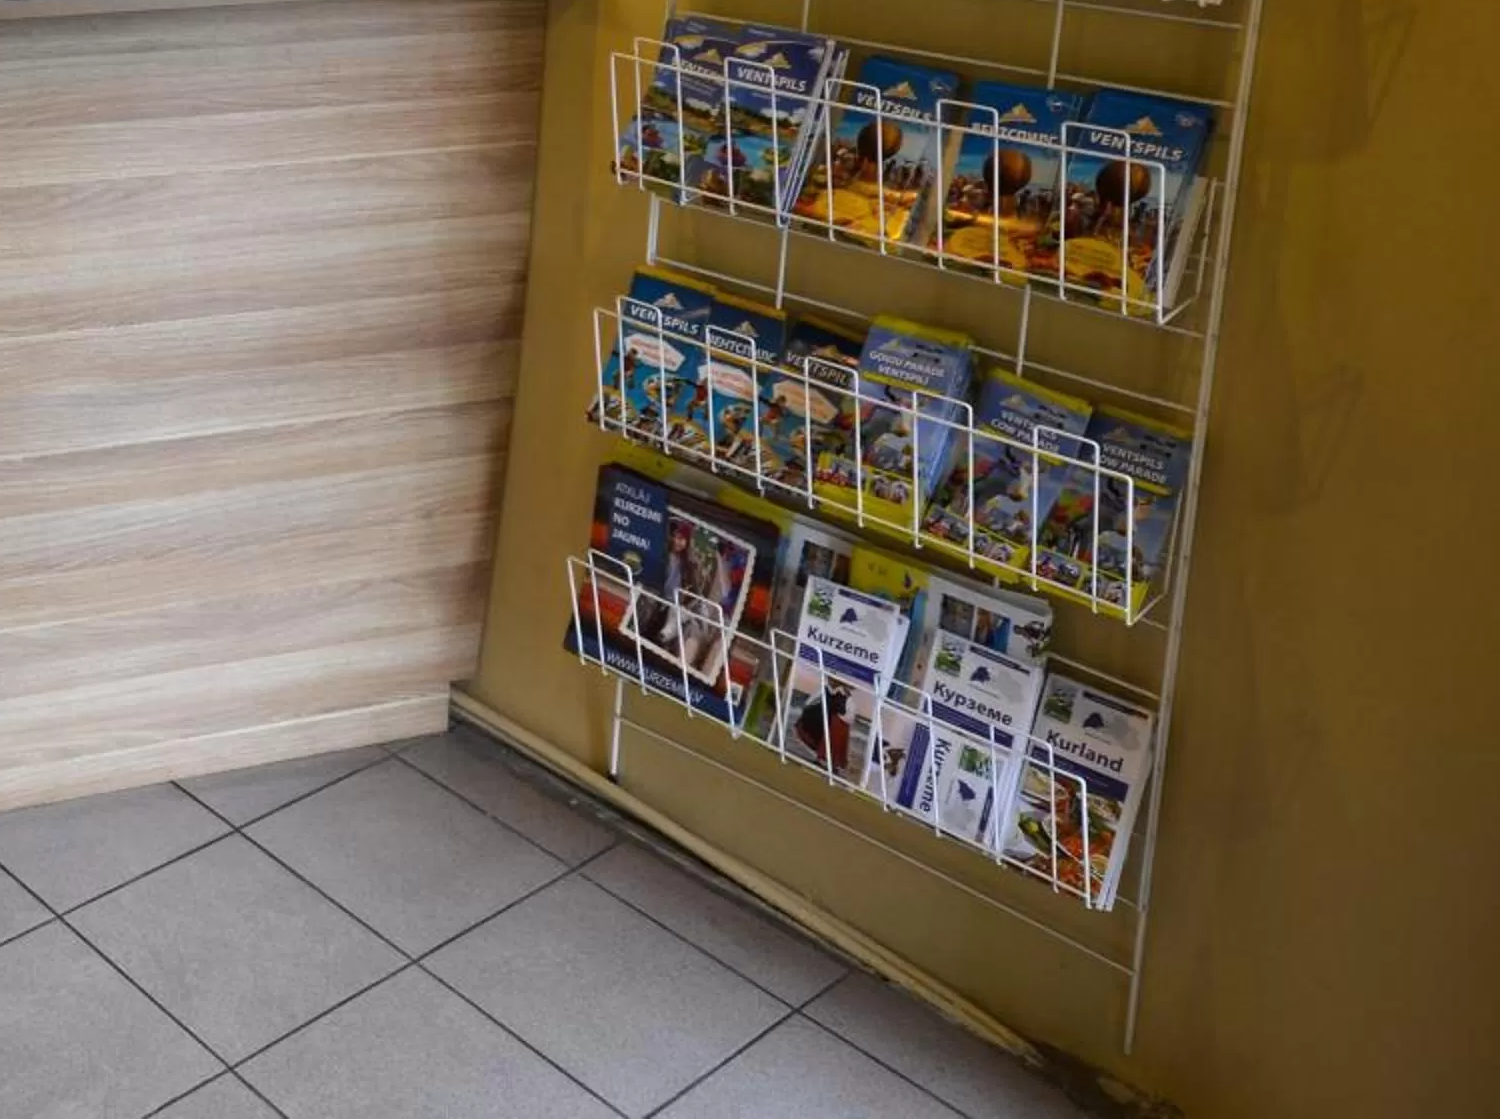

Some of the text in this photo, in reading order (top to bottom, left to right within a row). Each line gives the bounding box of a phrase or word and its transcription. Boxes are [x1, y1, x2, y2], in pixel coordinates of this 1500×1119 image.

[630, 304, 700, 336] VENSPILS
[613, 512, 631, 527] NO
[807, 624, 880, 664] Kurzeme
[933, 680, 1013, 726] Курземе
[1046, 728, 1125, 772] Kurland
